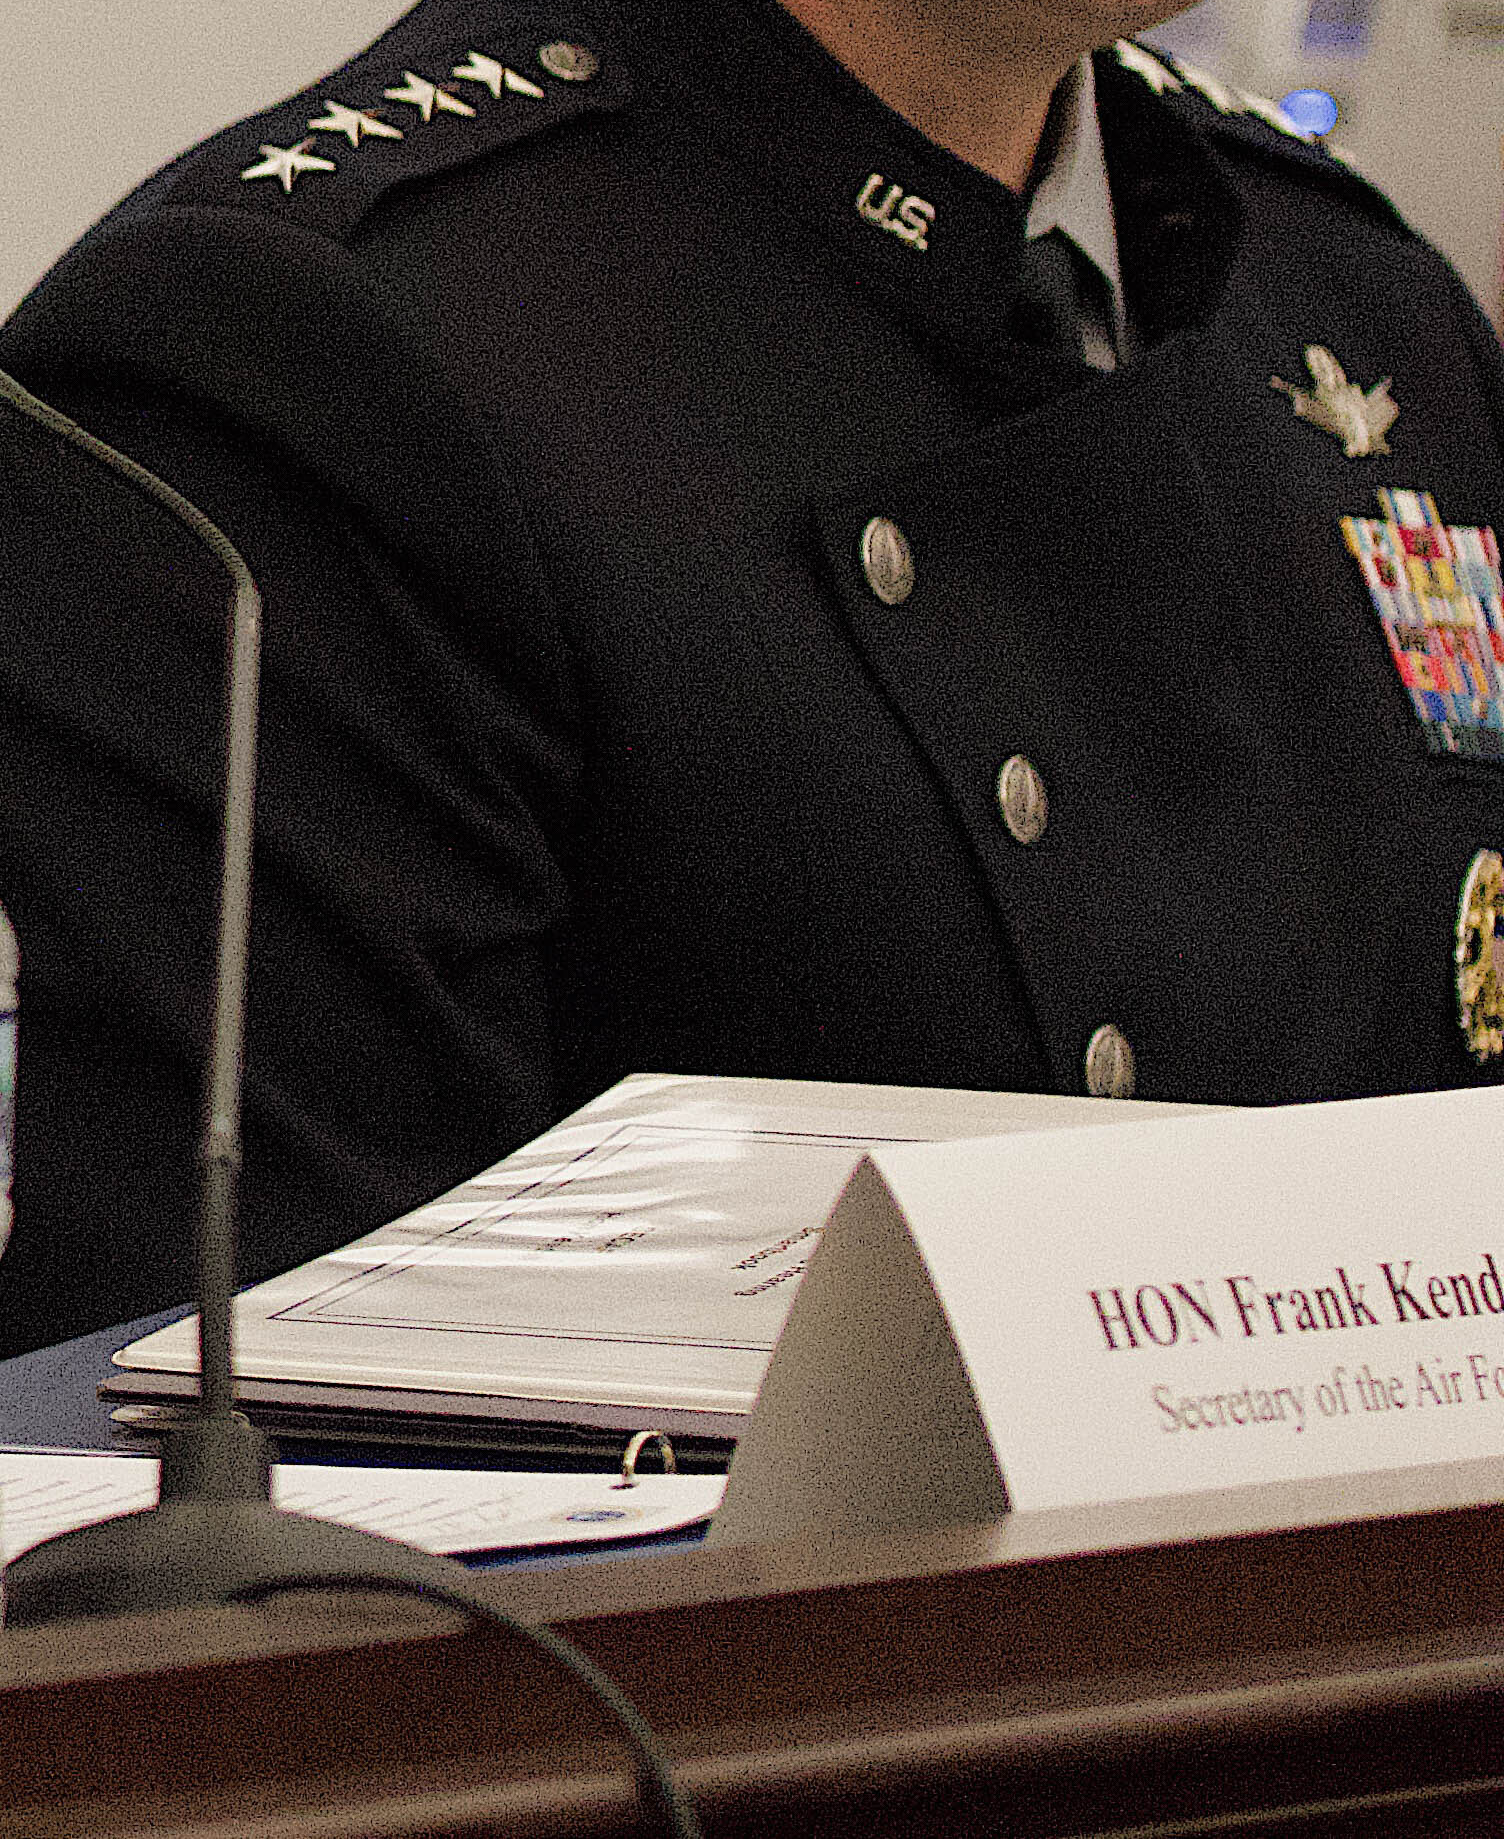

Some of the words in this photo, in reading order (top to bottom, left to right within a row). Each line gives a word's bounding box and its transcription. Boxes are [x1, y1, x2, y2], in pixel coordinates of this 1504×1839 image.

[1088, 1280, 1223, 1350] HON
[1225, 1267, 1380, 1337] Frank
[1151, 1383, 1305, 1433] Secretary
[1315, 1365, 1351, 1418] of
[1356, 1364, 1408, 1411] the
[1417, 1357, 1464, 1408] Air
